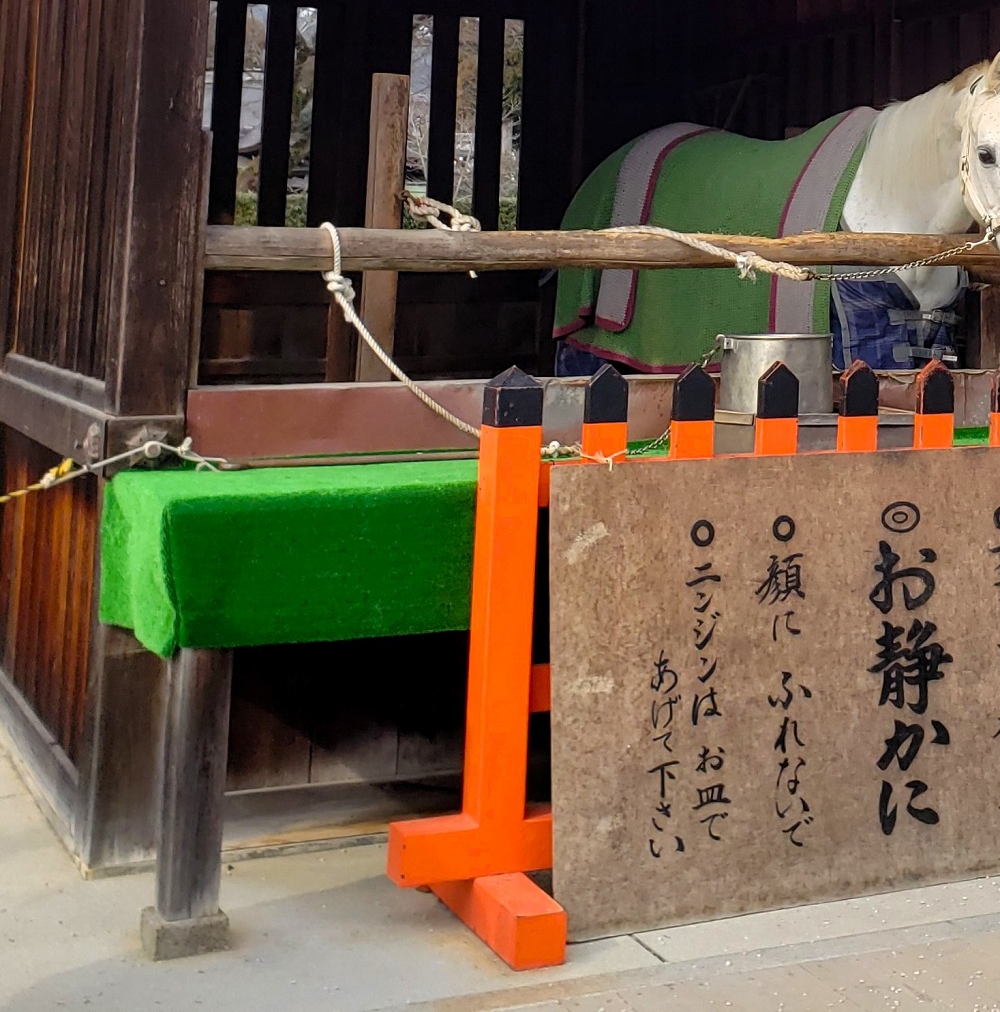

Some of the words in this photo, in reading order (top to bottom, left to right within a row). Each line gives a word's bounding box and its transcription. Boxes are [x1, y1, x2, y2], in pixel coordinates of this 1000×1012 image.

[647, 649, 685, 859] あげて下さい
[867, 539, 954, 837] お静かに
